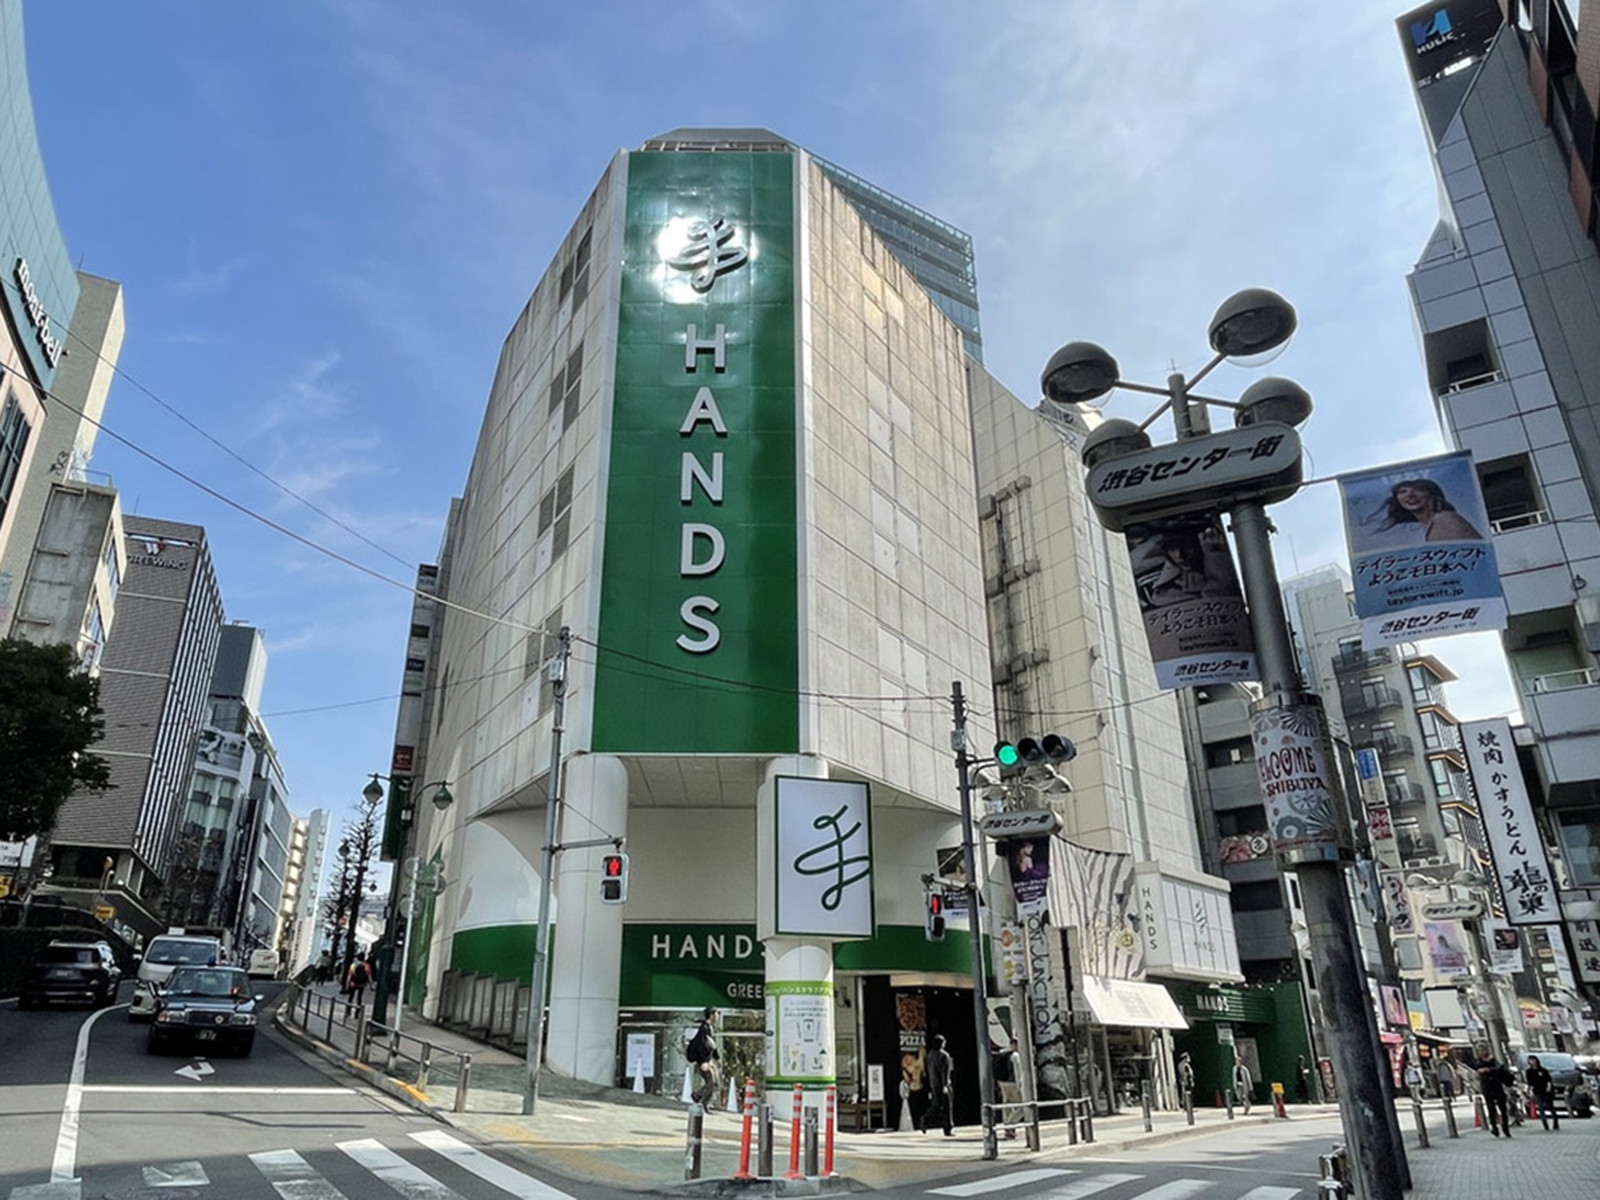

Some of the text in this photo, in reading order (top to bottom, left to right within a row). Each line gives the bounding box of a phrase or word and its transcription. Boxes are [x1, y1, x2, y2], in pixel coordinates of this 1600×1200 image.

[1416, 31, 1456, 55] HULIC
[1098, 434, 1285, 493] 渋谷センター街
[676, 323, 728, 654] HANDS
[1356, 547, 1487, 574] テイラー・スウィフト
[1387, 588, 1464, 606] taylorswift.jp
[1379, 606, 1480, 634] 渋谷センター街
[1266, 776, 1328, 798] SHIBUYA
[1142, 886, 1159, 950] HANDS
[652, 934, 765, 958] HAND
[727, 982, 765, 999] GREE
[1030, 945, 1051, 1035] JUNCTION
[900, 1035, 927, 1046] PIZZA
